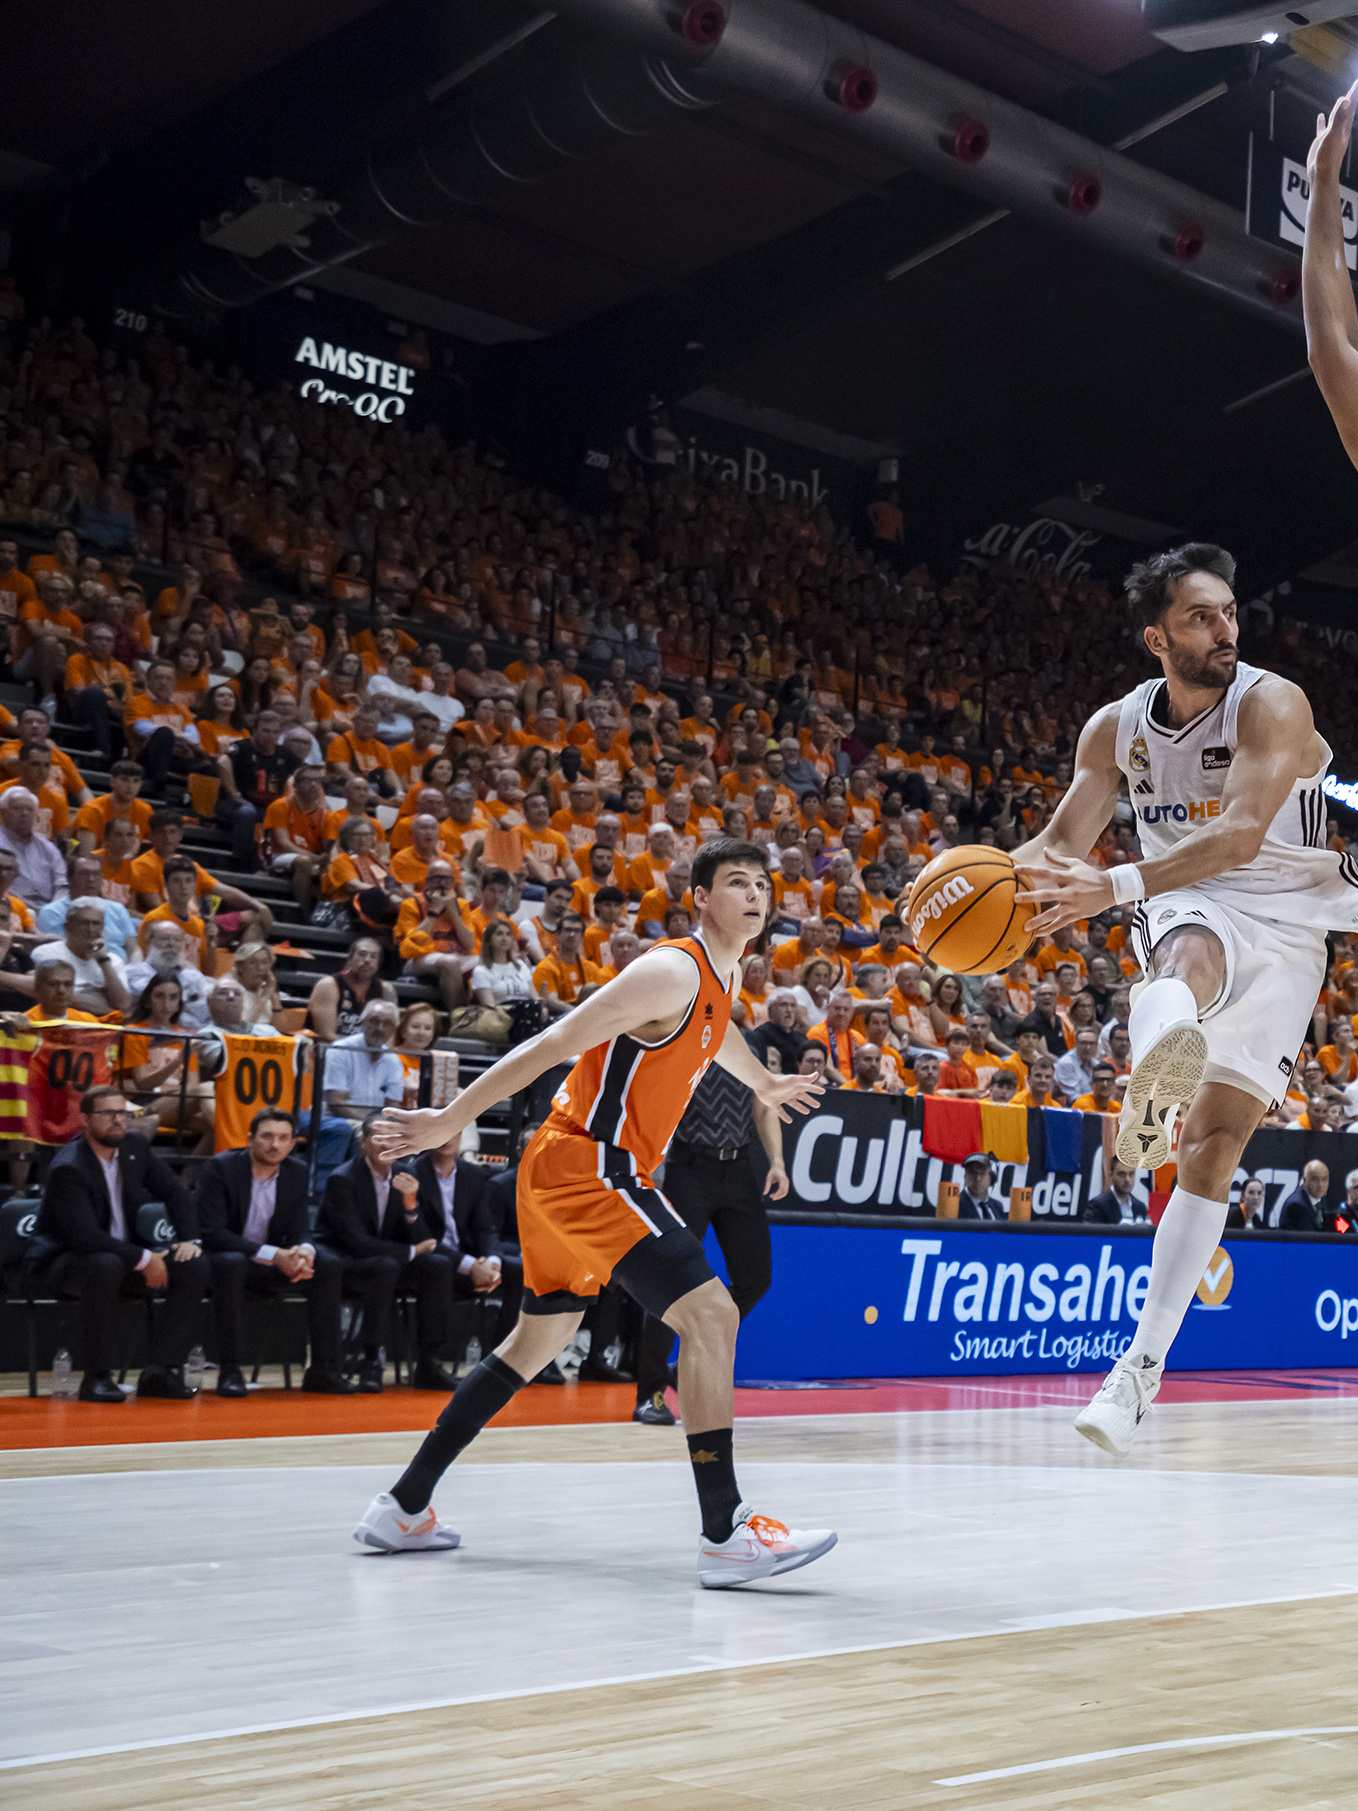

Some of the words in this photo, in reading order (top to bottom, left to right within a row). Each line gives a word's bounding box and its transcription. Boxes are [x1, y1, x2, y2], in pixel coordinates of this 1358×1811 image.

[294, 336, 416, 396] AMSTEL
[47, 1049, 94, 1092] 00
[235, 1056, 283, 1107] 00
[950, 1330, 1038, 1362] Smart
